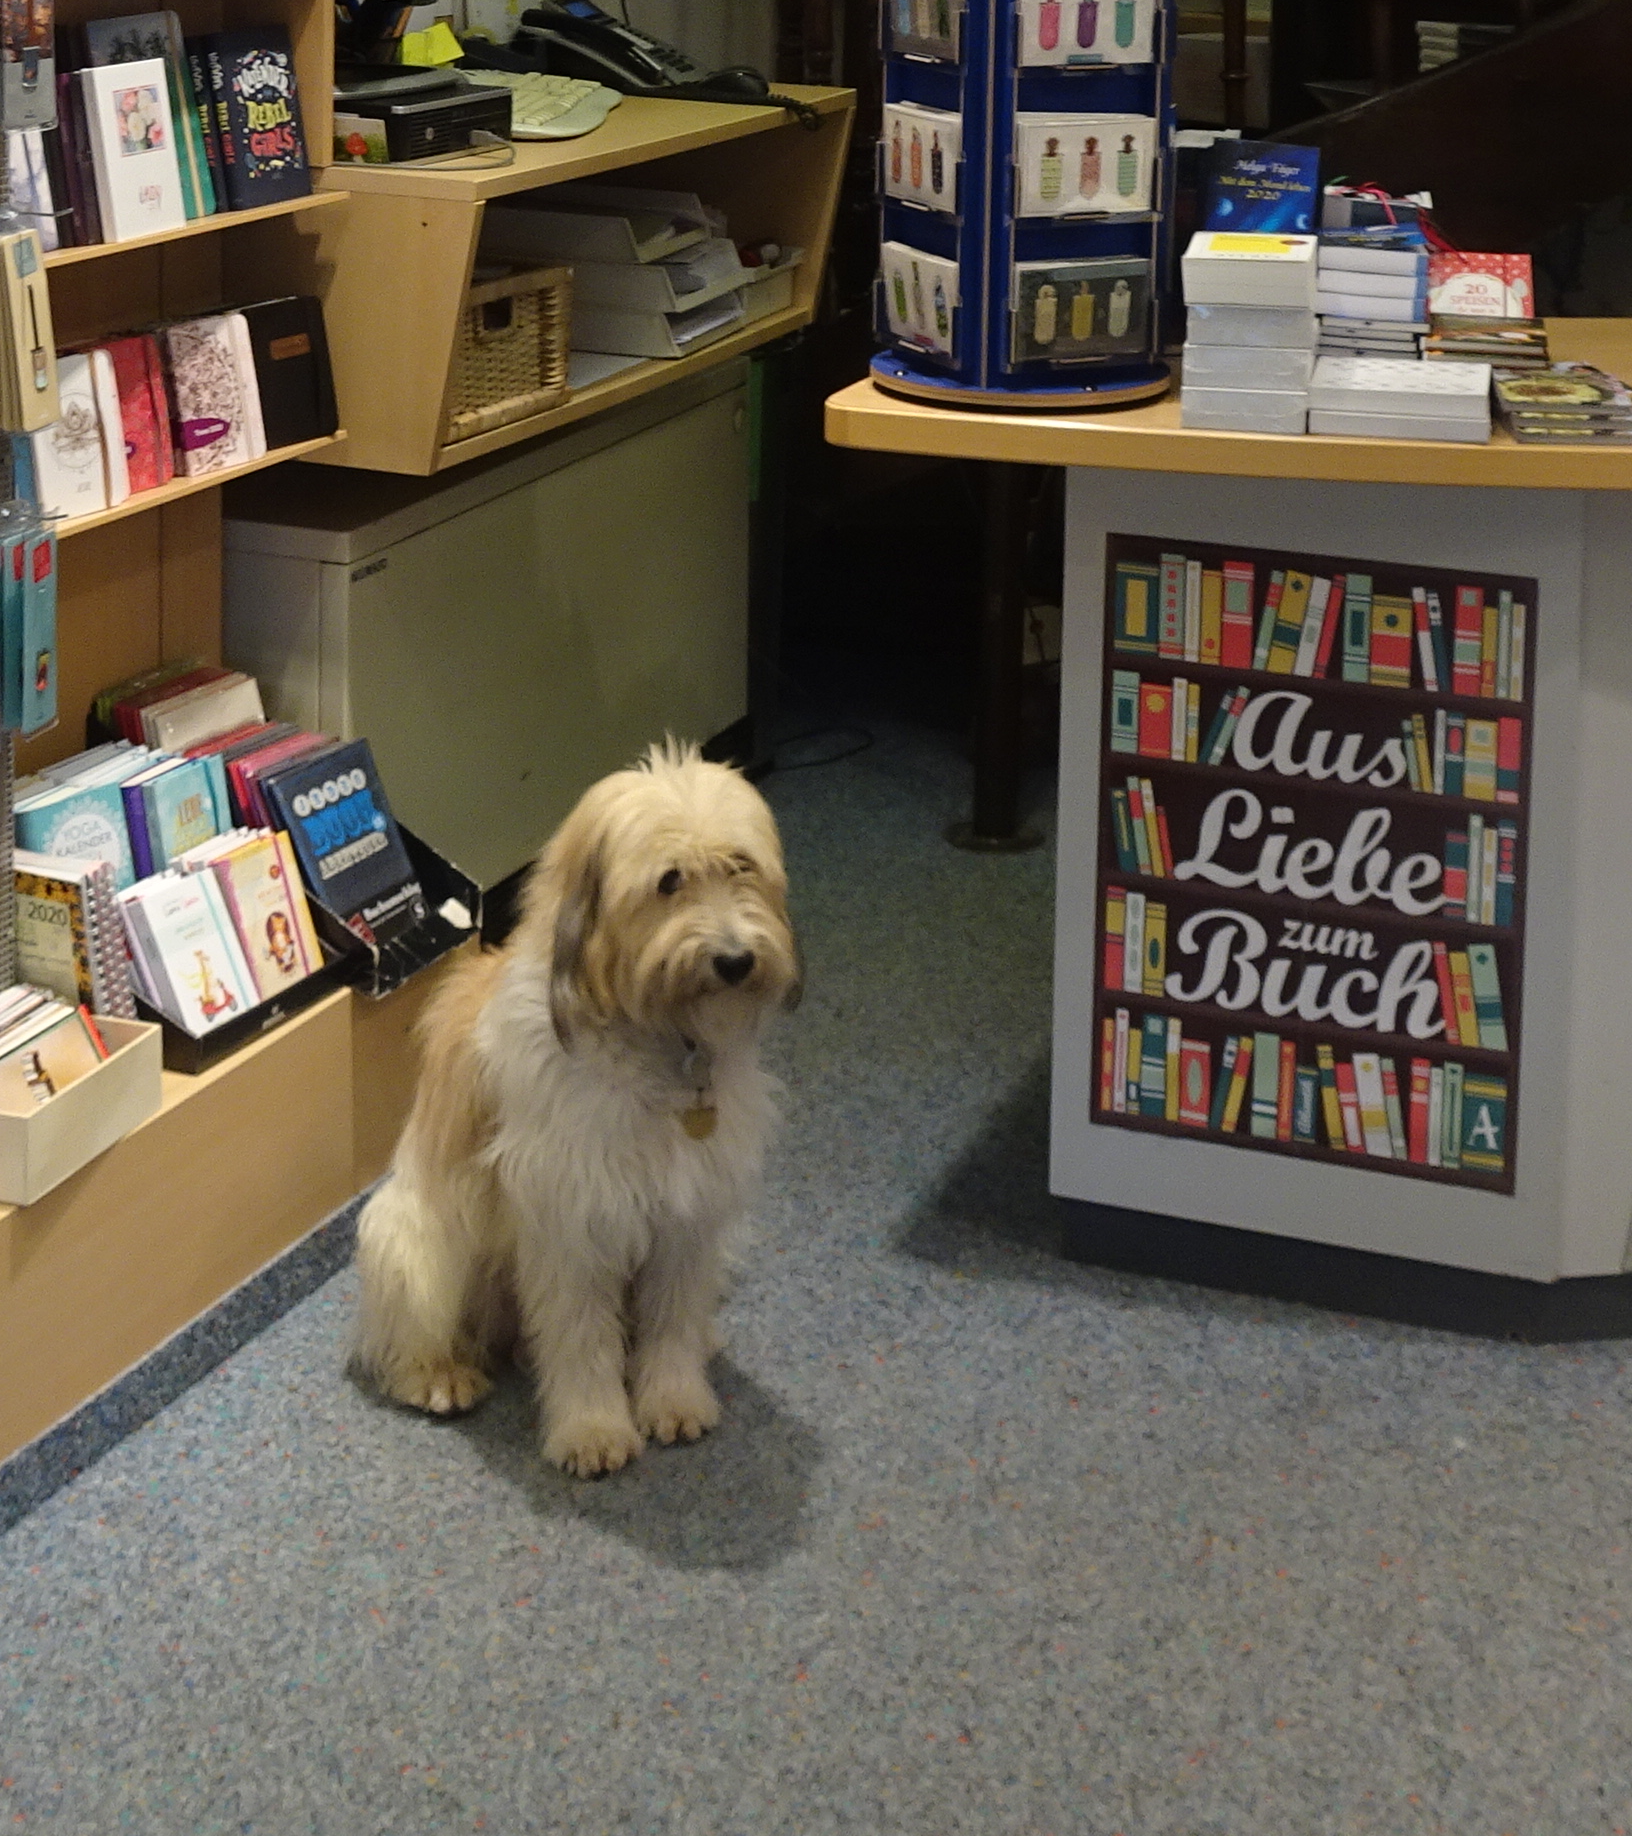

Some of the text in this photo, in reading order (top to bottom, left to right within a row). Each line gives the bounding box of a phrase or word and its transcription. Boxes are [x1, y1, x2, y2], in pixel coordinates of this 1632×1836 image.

[246, 97, 292, 131] REBEL
[249, 125, 296, 157] GIRLS
[1244, 188, 1282, 201] 2020
[1232, 690, 1409, 789] Aus
[62, 820, 102, 842] YOGA
[1172, 787, 1449, 918] Liebe
[28, 902, 68, 927] 2020
[1279, 917, 1379, 961] zum
[1165, 907, 1447, 1040] Buch
[1469, 1101, 1501, 1151] A
